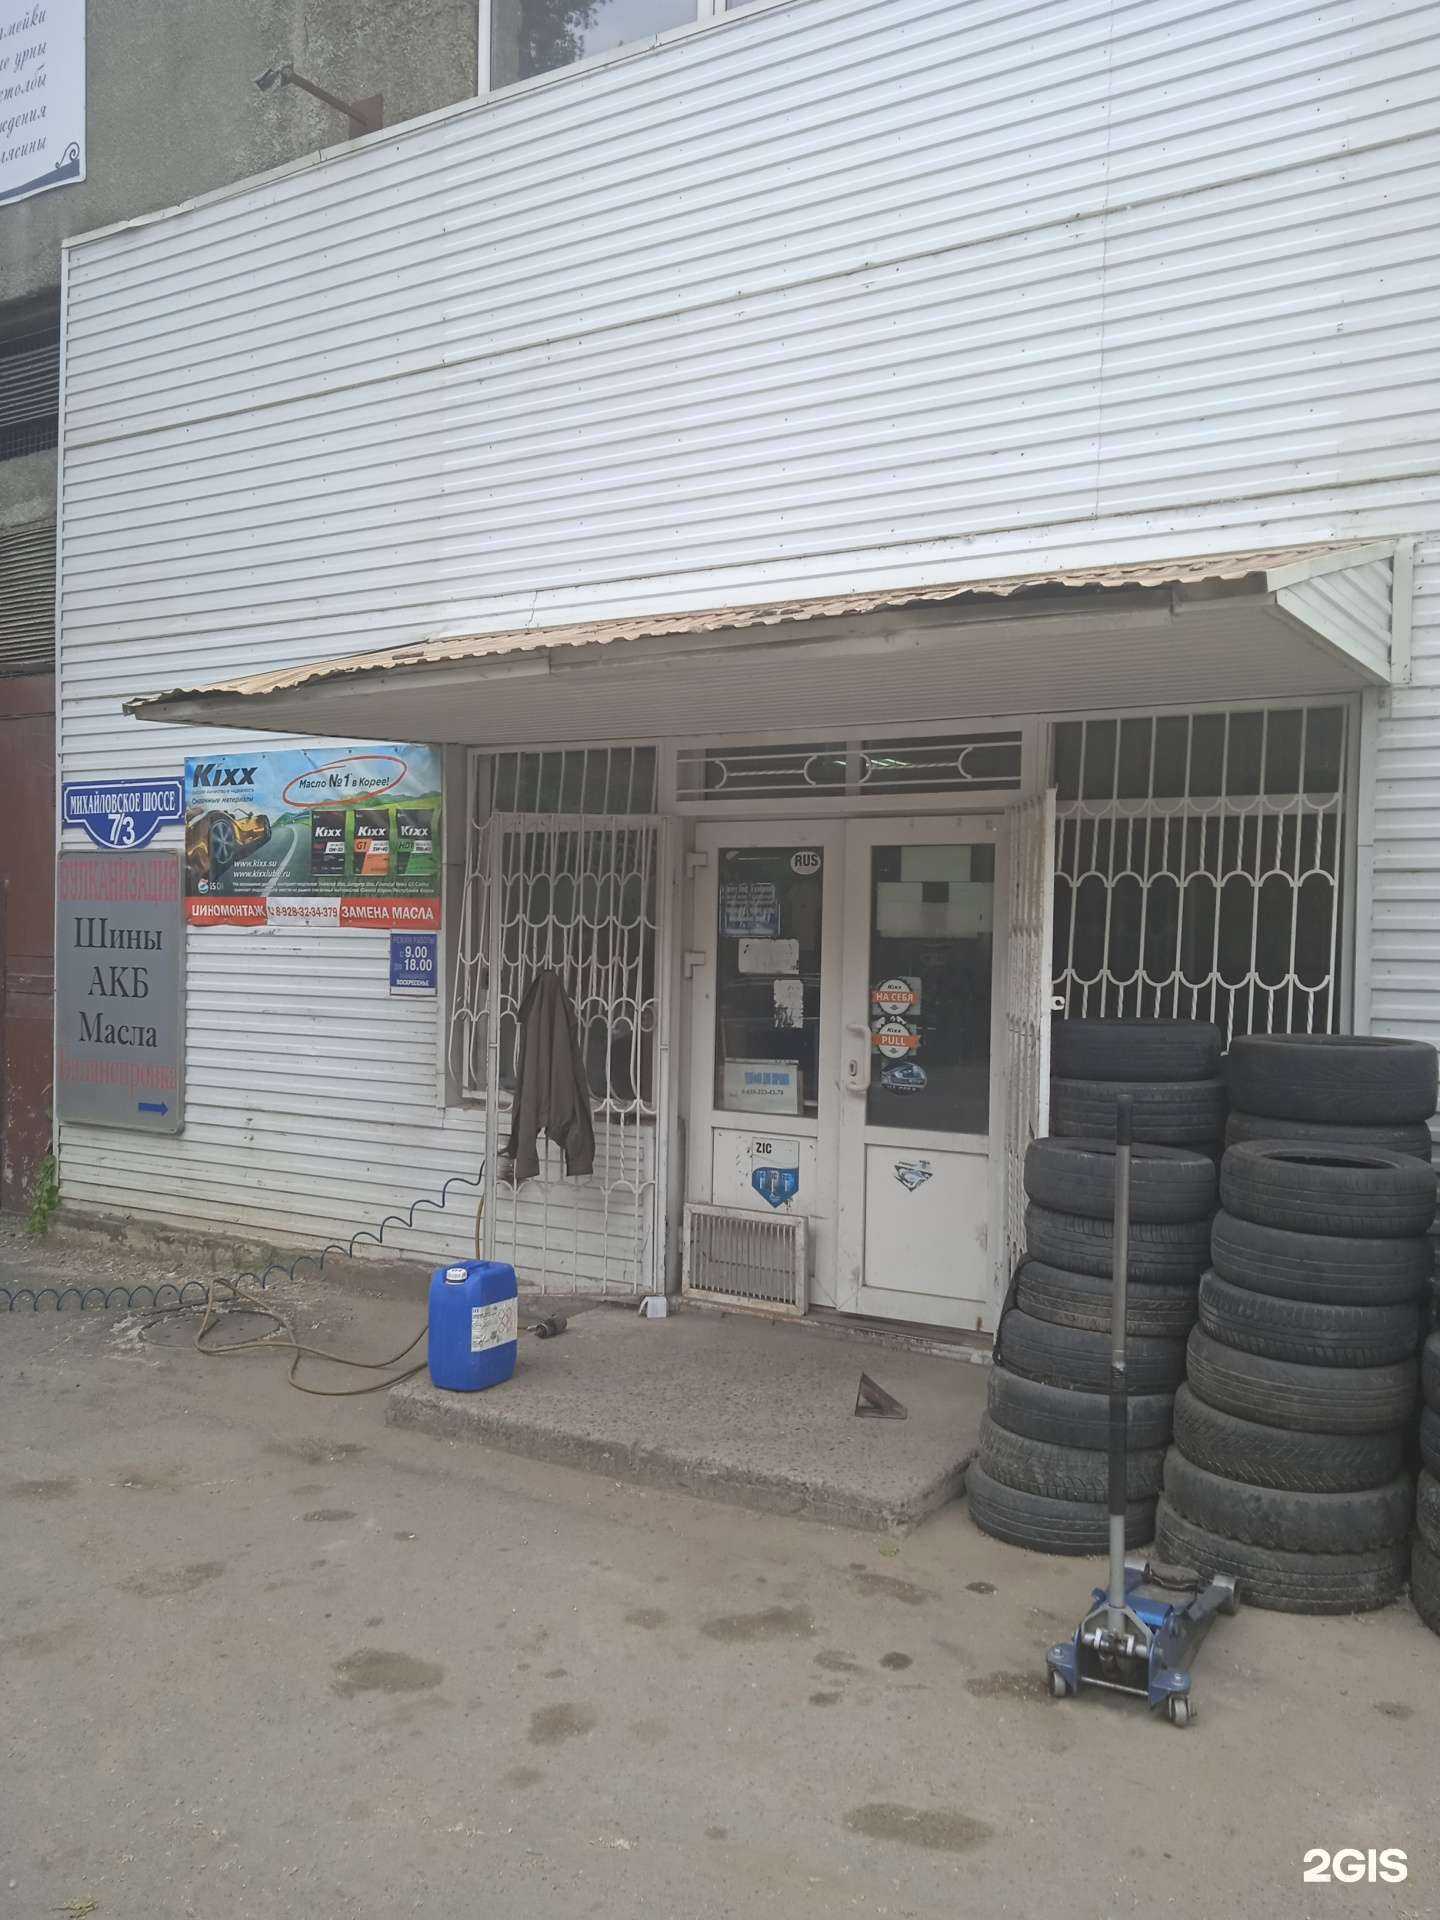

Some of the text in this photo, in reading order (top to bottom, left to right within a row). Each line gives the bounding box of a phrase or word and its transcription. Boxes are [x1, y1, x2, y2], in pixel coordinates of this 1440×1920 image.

[13, 42, 47, 73] урны
[193, 763, 258, 787] Kixx
[299, 779, 327, 789] Масло
[358, 777, 390, 788] Корее!
[70, 791, 176, 815] МИХАЙЛОВСКОЕ ШОССЕ
[107, 813, 136, 845] 7/3
[315, 826, 343, 838] Kixx
[357, 825, 387, 837] Kixx
[400, 825, 429, 837] Kixx
[233, 860, 278, 868] www.kixx.su
[794, 854, 818, 867] RUS
[341, 906, 434, 920] ЗАМЕНА МАСЛА
[74, 917, 162, 950] Шины
[405, 945, 428, 958] 9.00
[404, 959, 433, 971] 18.00
[88, 966, 149, 998] АКБ
[876, 992, 914, 1002] НА СЕБЯ
[78, 1011, 158, 1048] Масла
[881, 1035, 906, 1046] PULL
[755, 1142, 773, 1155] ZIC
